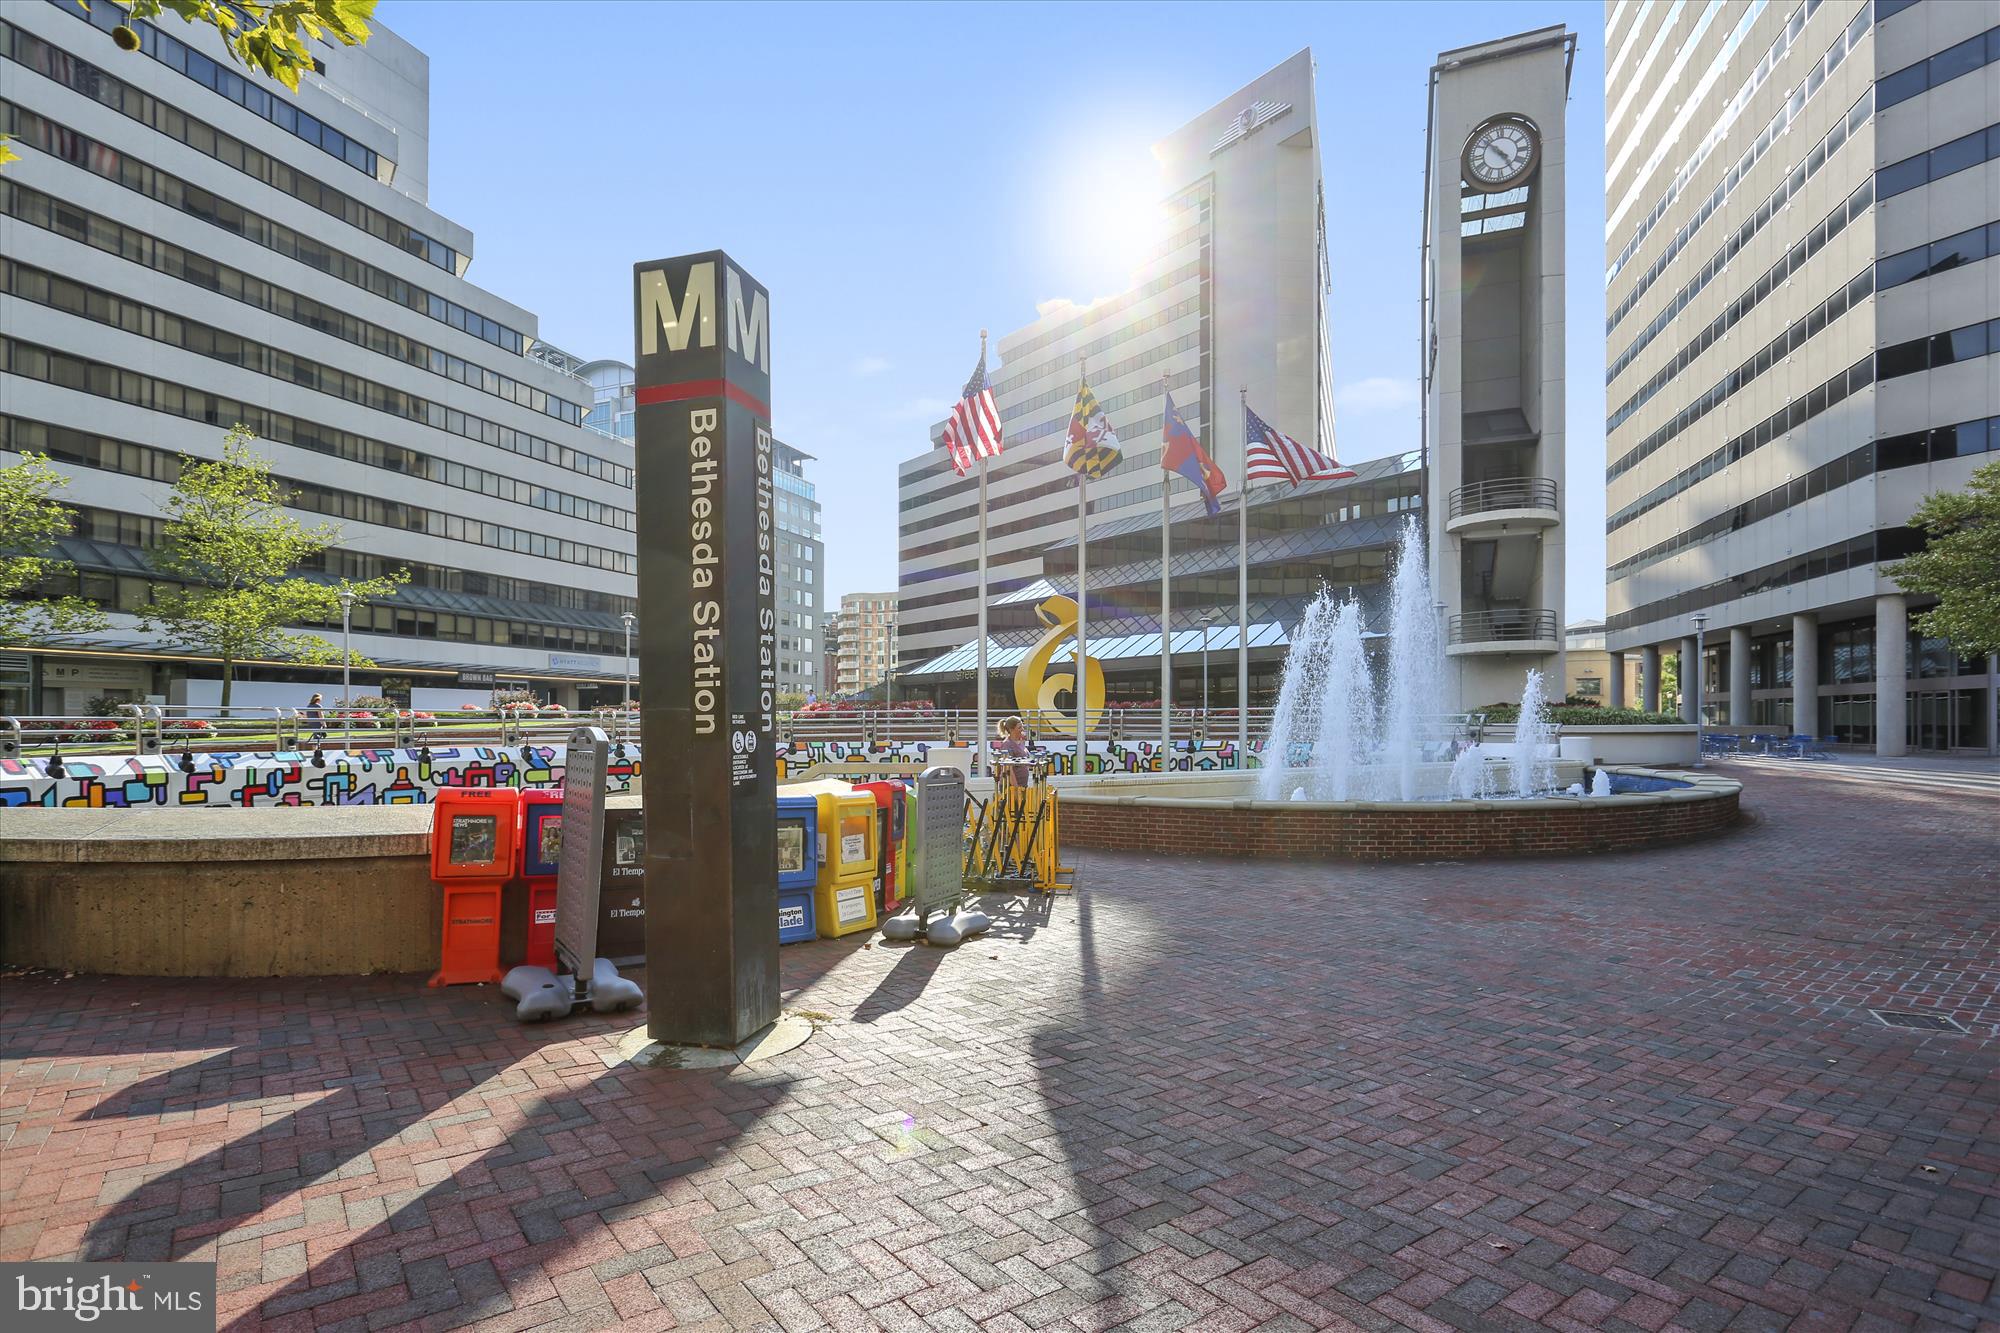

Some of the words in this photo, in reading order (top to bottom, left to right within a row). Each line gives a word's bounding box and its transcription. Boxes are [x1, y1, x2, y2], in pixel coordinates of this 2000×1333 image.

[640, 261, 716, 356] M
[726, 264, 768, 375] M
[690, 408, 719, 588] Bethesda
[756, 427, 773, 596] Bethesda
[462, 673, 481, 681] BROWN
[482, 674, 493, 682] BAG
[692, 601, 721, 735] Station
[760, 607, 774, 732] Station
[611, 909, 618, 918] El
[619, 908, 645, 917] Tiempo
[613, 867, 620, 876] El
